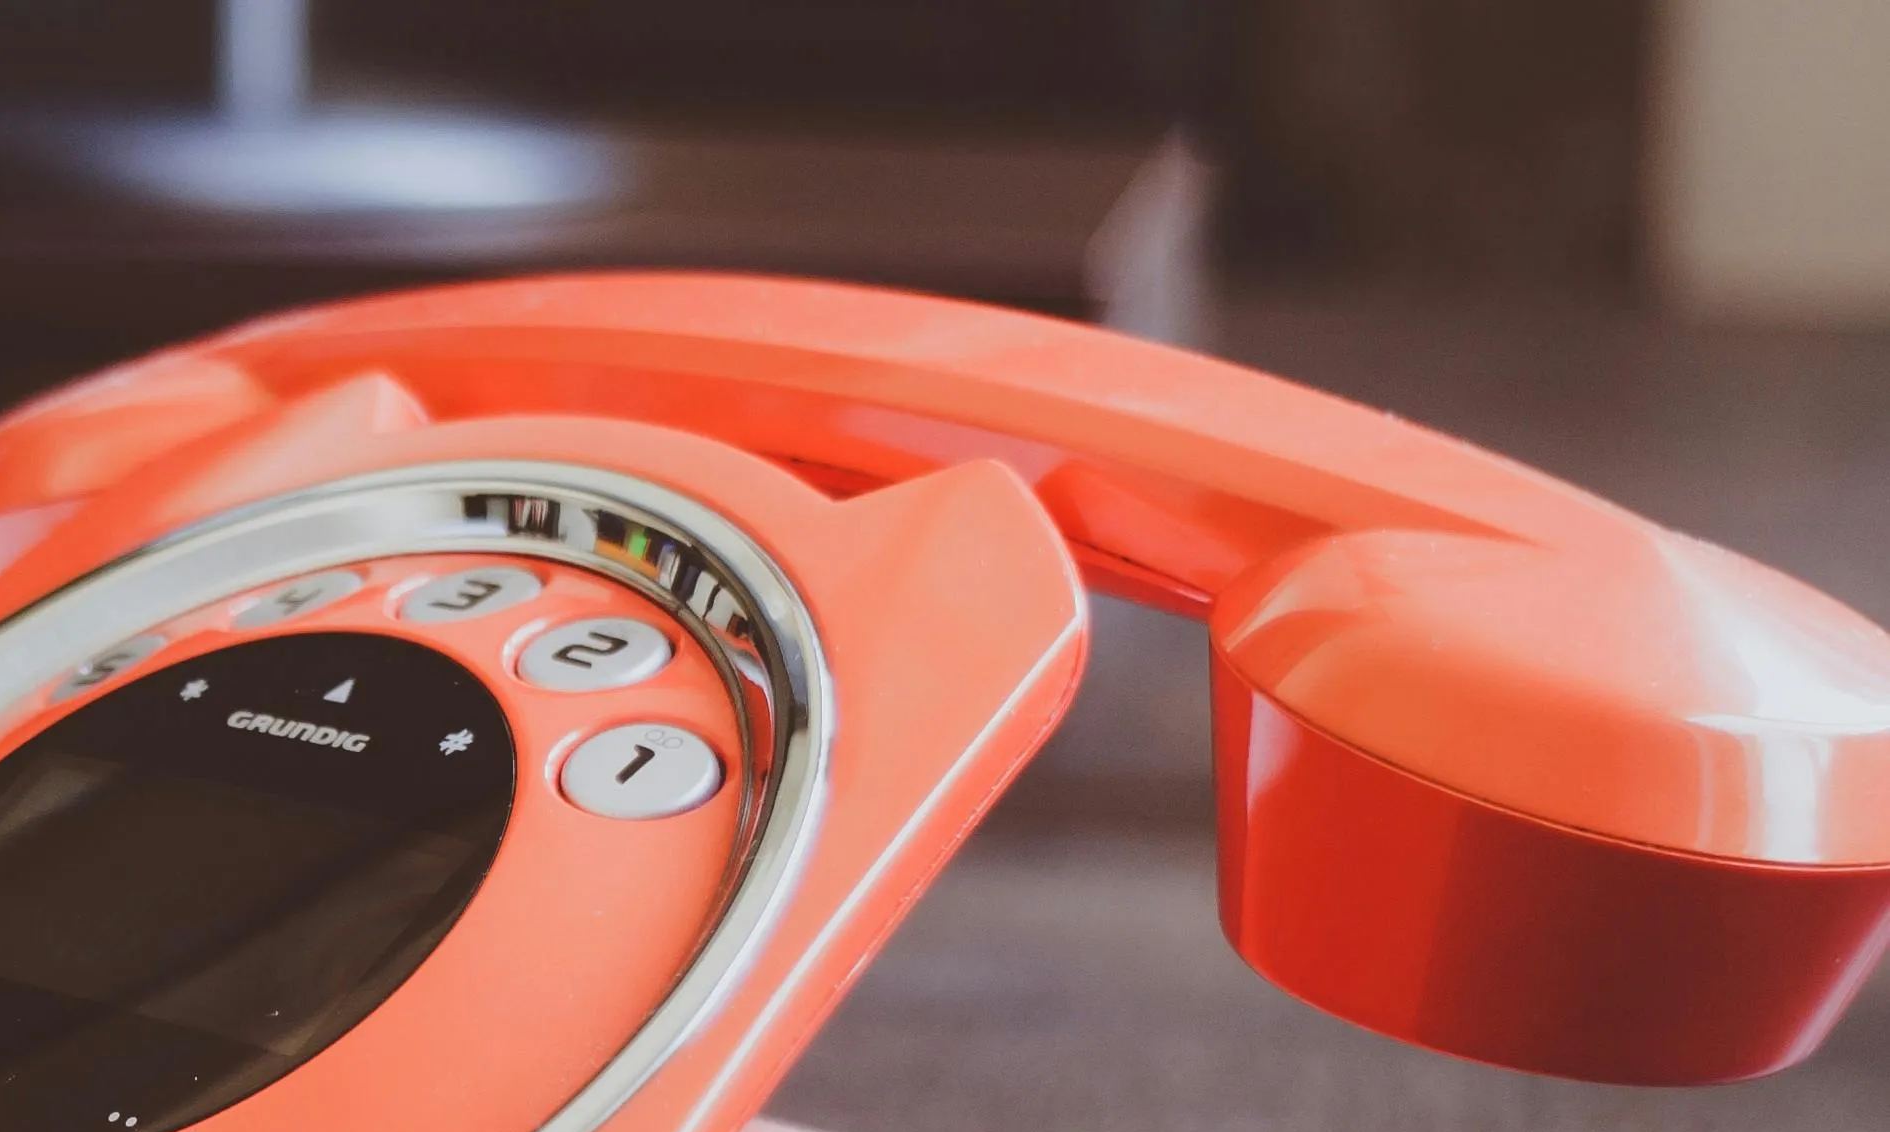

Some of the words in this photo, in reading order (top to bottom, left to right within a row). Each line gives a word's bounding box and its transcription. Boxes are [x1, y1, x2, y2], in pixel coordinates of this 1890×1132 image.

[273, 587, 324, 616] 4
[426, 579, 502, 611] 3
[552, 631, 629, 669] 2
[227, 711, 370, 752] GRUNDIG
[615, 744, 656, 785] 1
